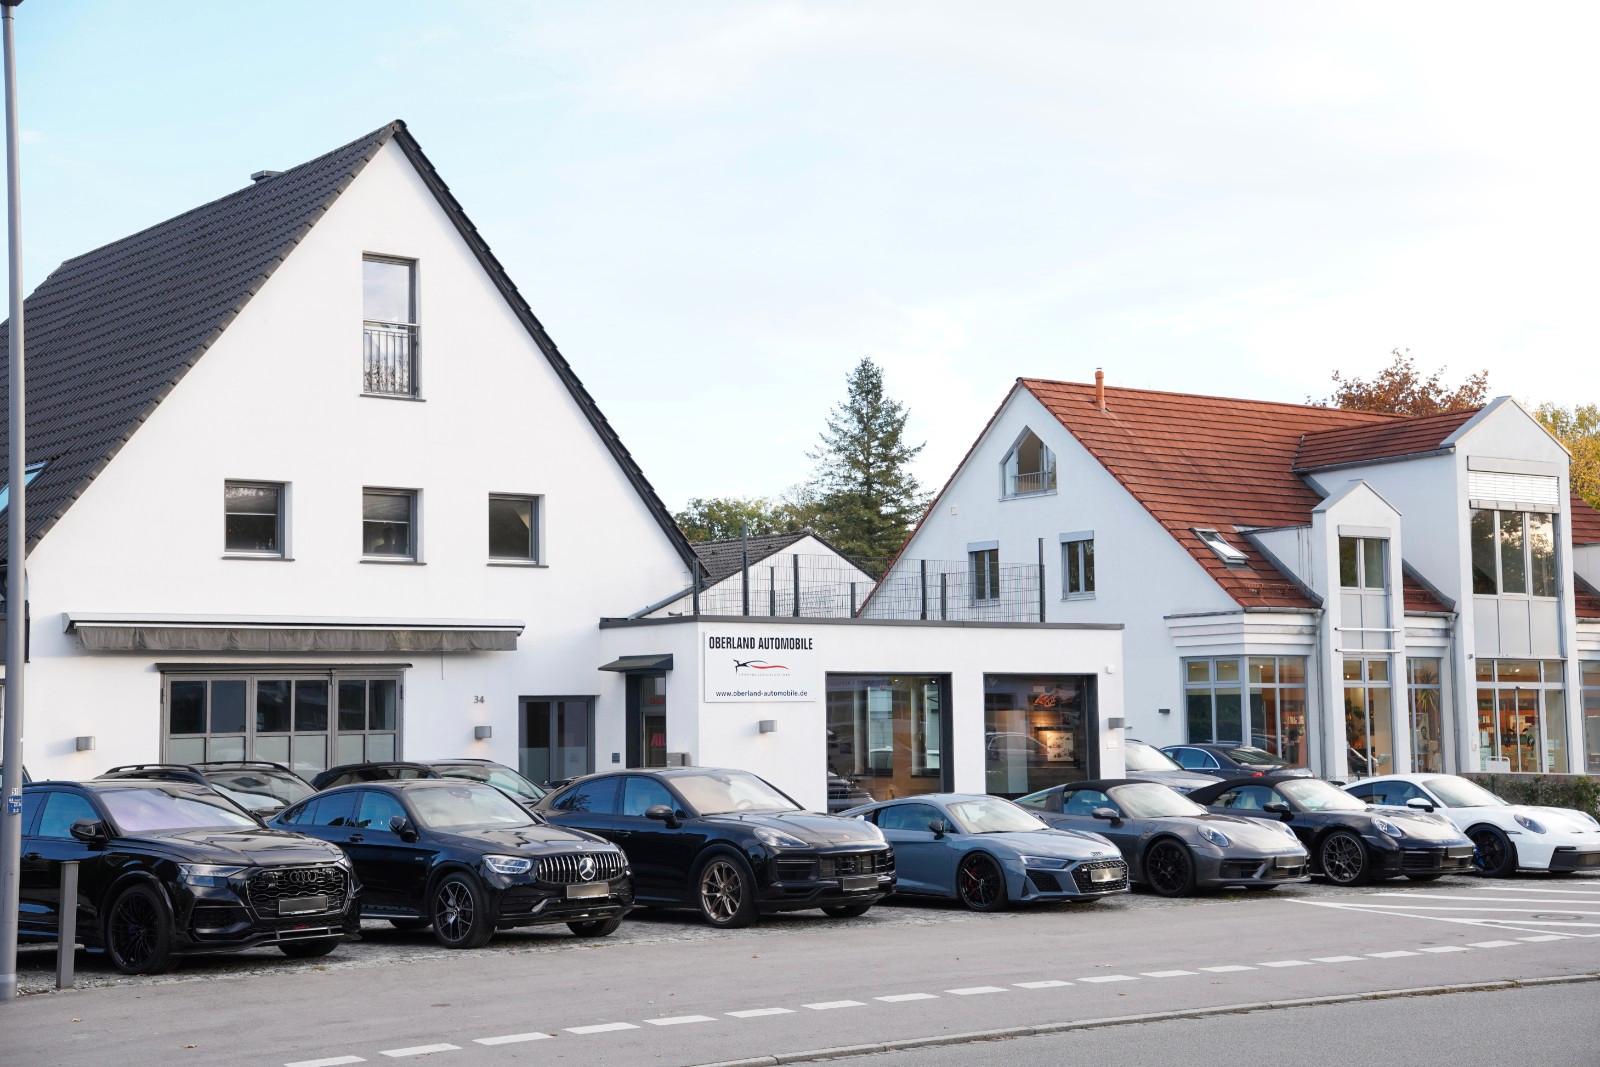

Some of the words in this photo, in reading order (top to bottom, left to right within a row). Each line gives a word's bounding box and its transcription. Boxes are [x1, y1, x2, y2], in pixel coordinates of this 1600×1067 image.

[709, 636, 755, 650] OBERLAND
[758, 637, 813, 651] AUTOMOBILE
[715, 689, 808, 697] www.oberland-automobile.de
[473, 695, 485, 704] 34
